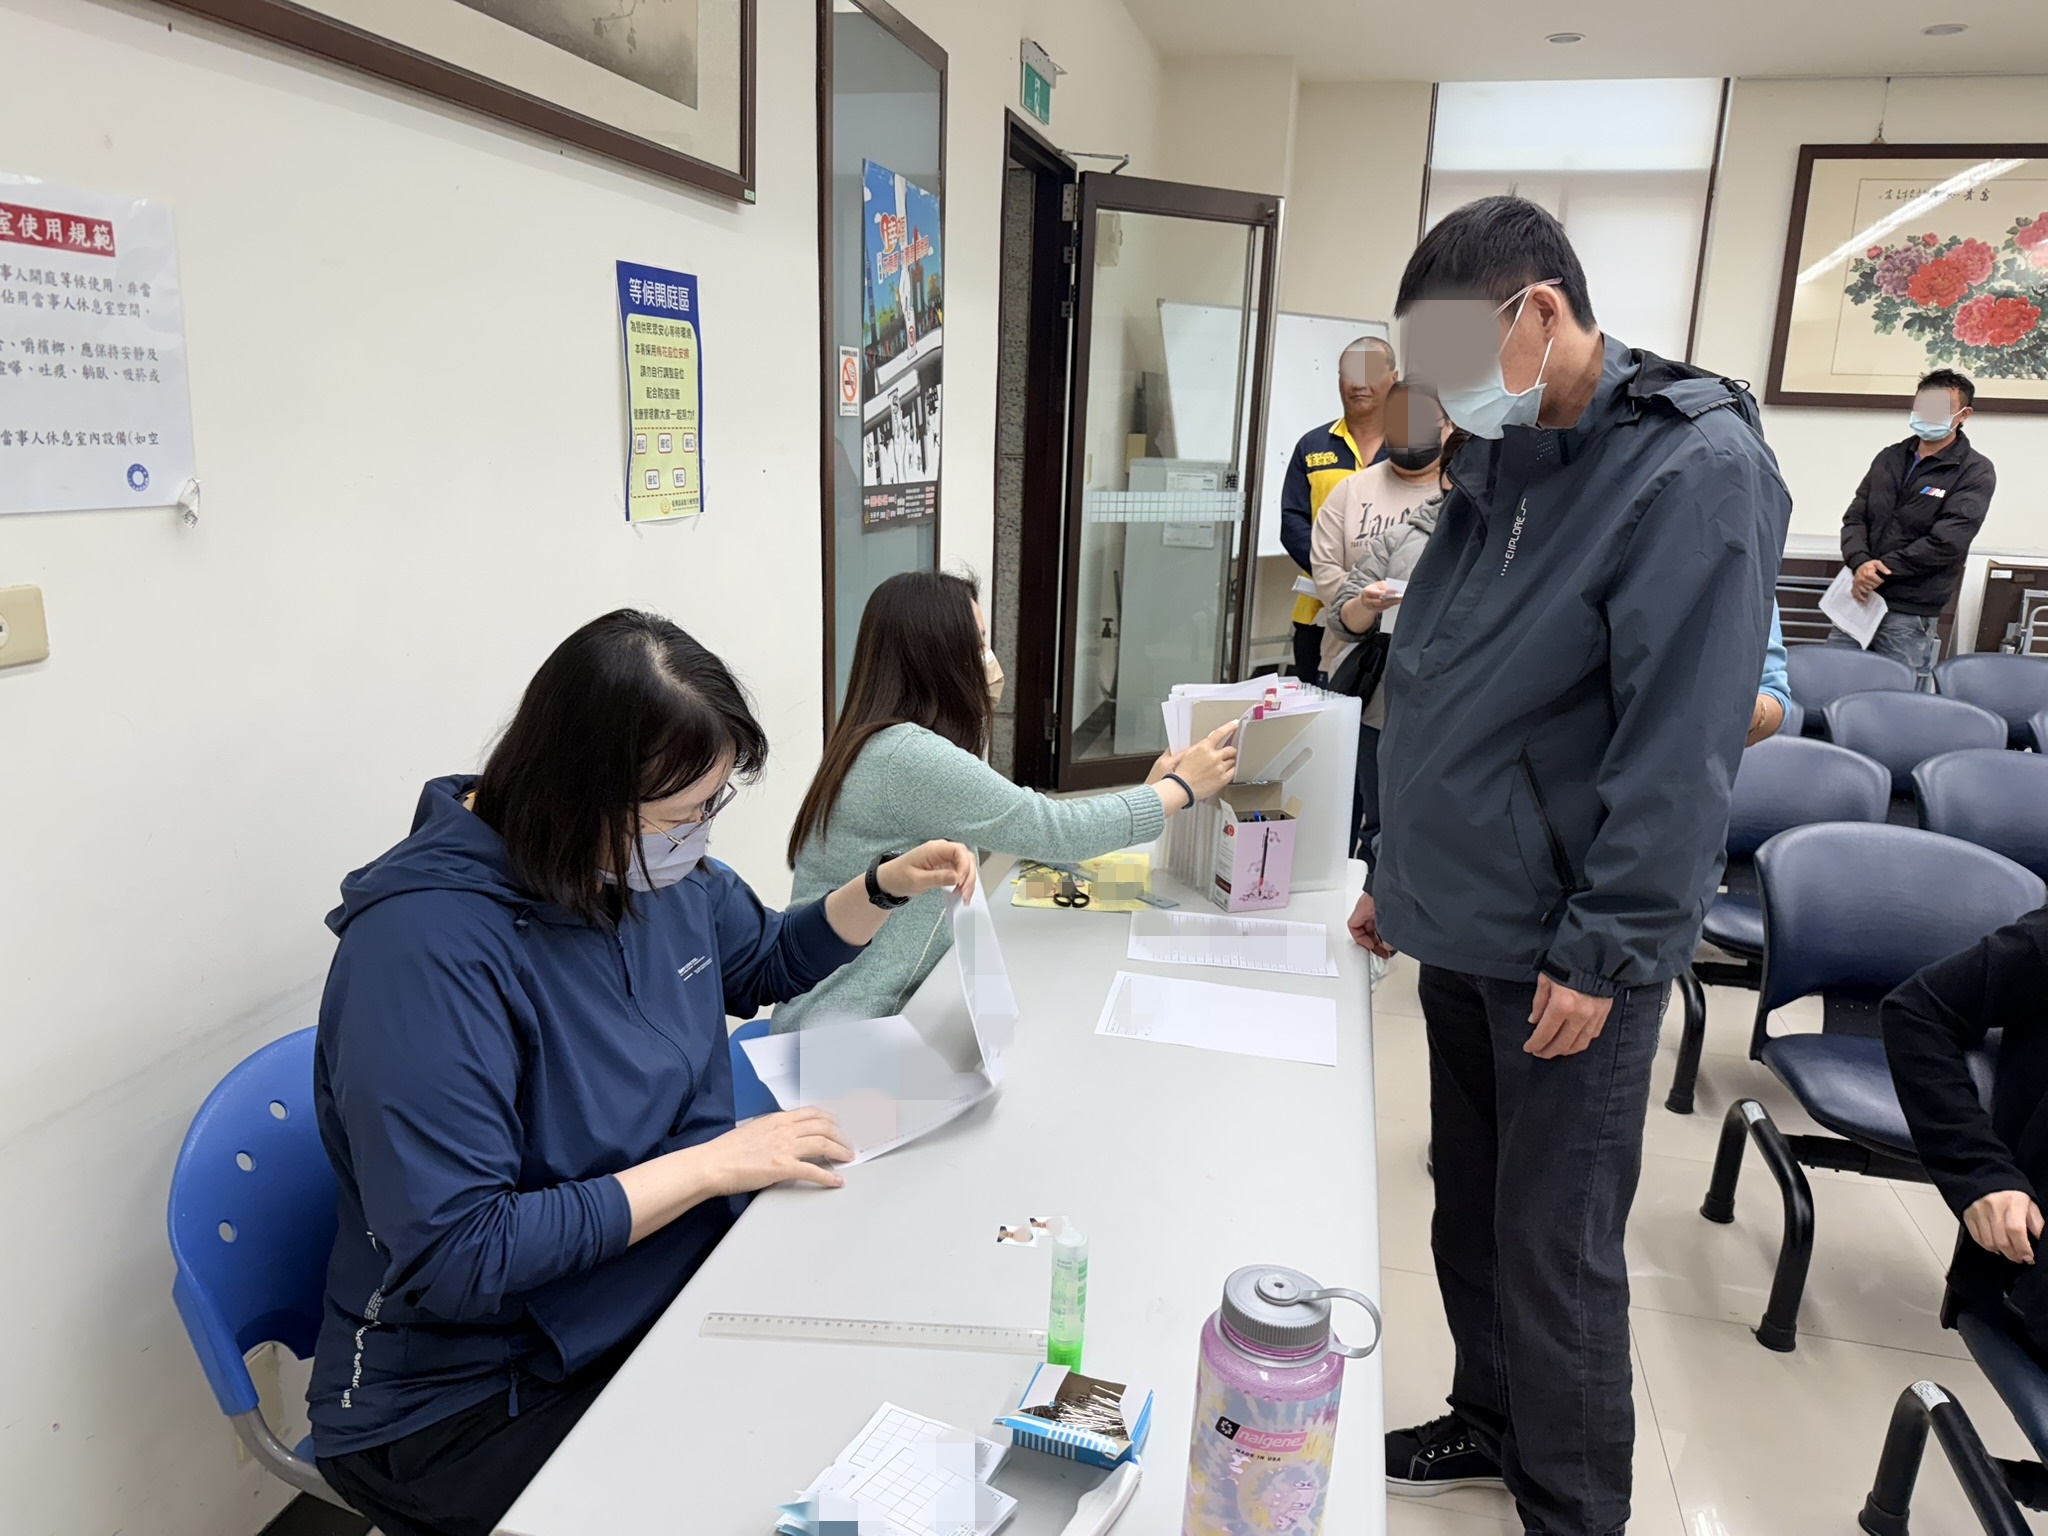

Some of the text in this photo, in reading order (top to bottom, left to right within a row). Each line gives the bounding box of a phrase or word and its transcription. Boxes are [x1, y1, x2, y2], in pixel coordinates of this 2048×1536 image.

[0, 208, 114, 251] 室使用規範
[628, 277, 690, 312] 等候開庭區
[0, 337, 159, 361] 、嚼檳榔，應保持安靜及
[646, 387, 680, 400] 配合防疫措施
[1225, 473, 1238, 489] 推
[1238, 1431, 1304, 1449] nalgene
[1235, 1448, 1255, 1458] MADE
